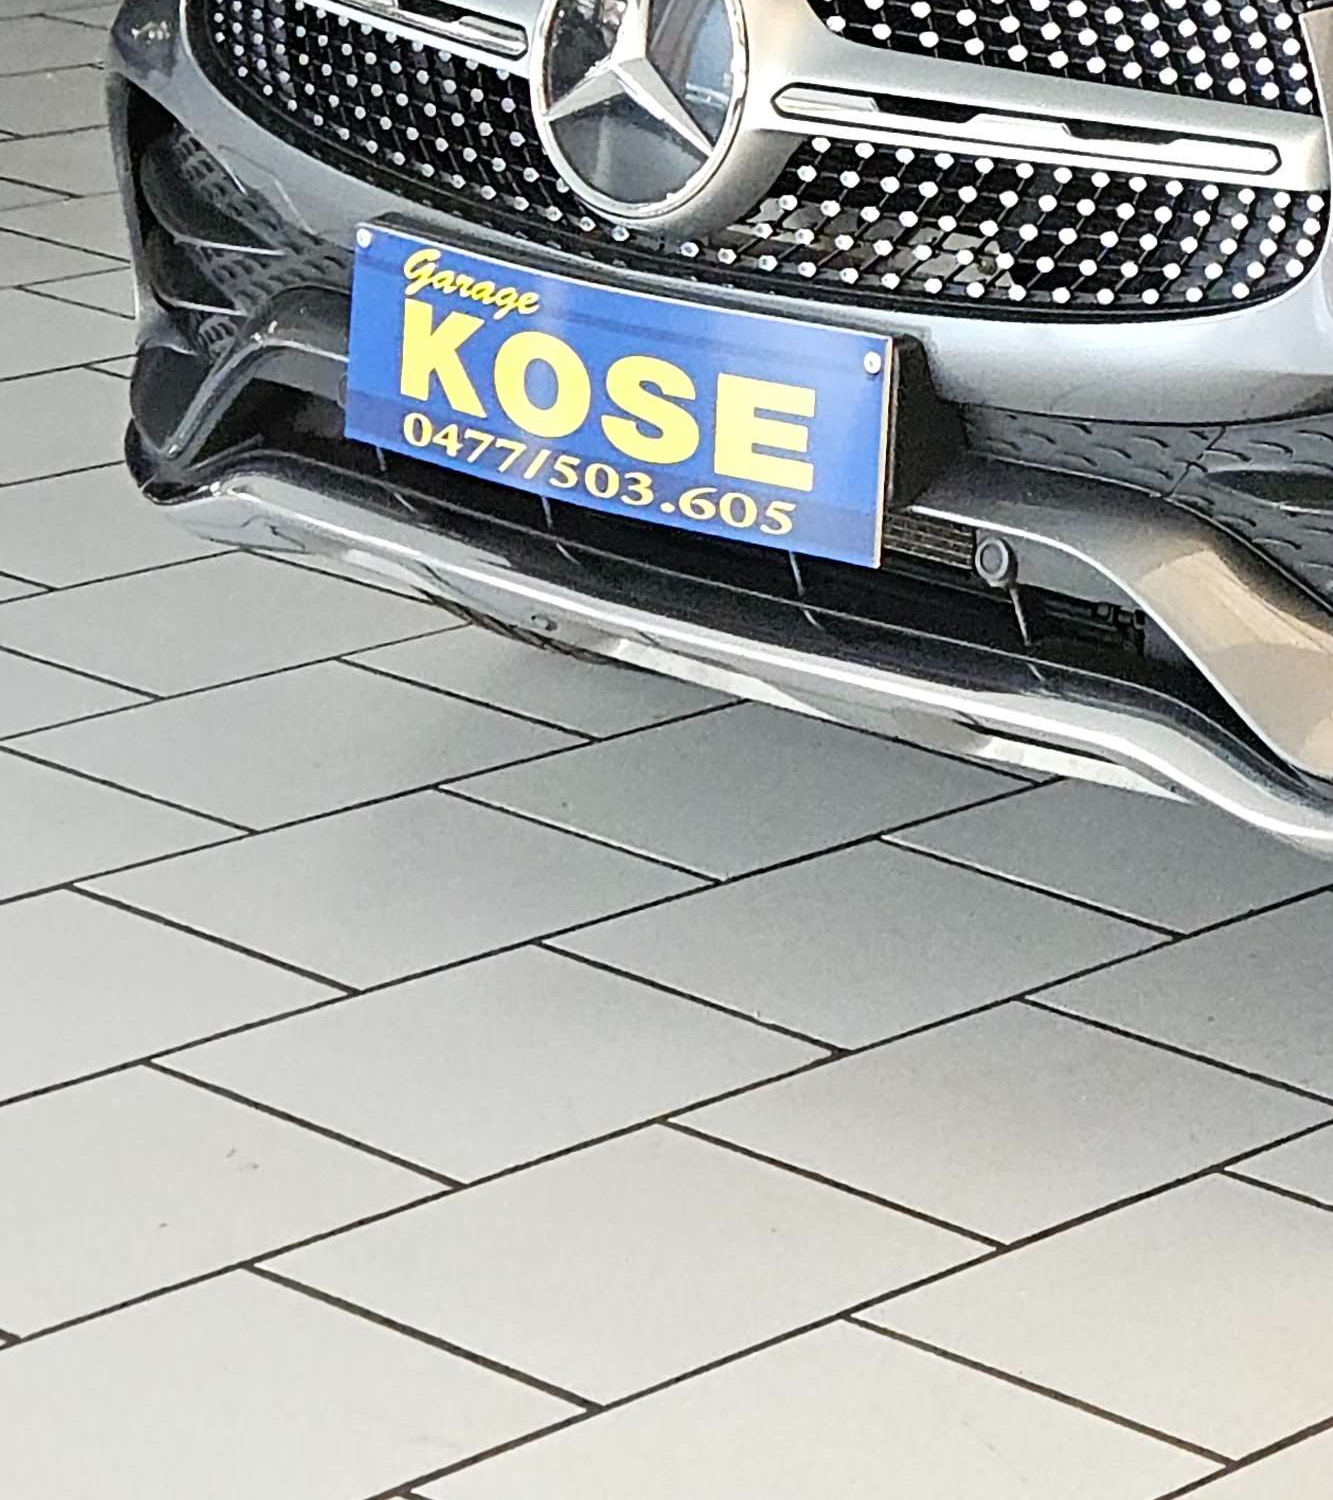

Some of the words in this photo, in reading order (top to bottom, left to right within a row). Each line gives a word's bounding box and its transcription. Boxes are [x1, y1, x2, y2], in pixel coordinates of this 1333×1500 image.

[403, 249, 540, 319] Garage
[400, 299, 817, 491] KOSE
[402, 412, 796, 535] 0477/503.605
